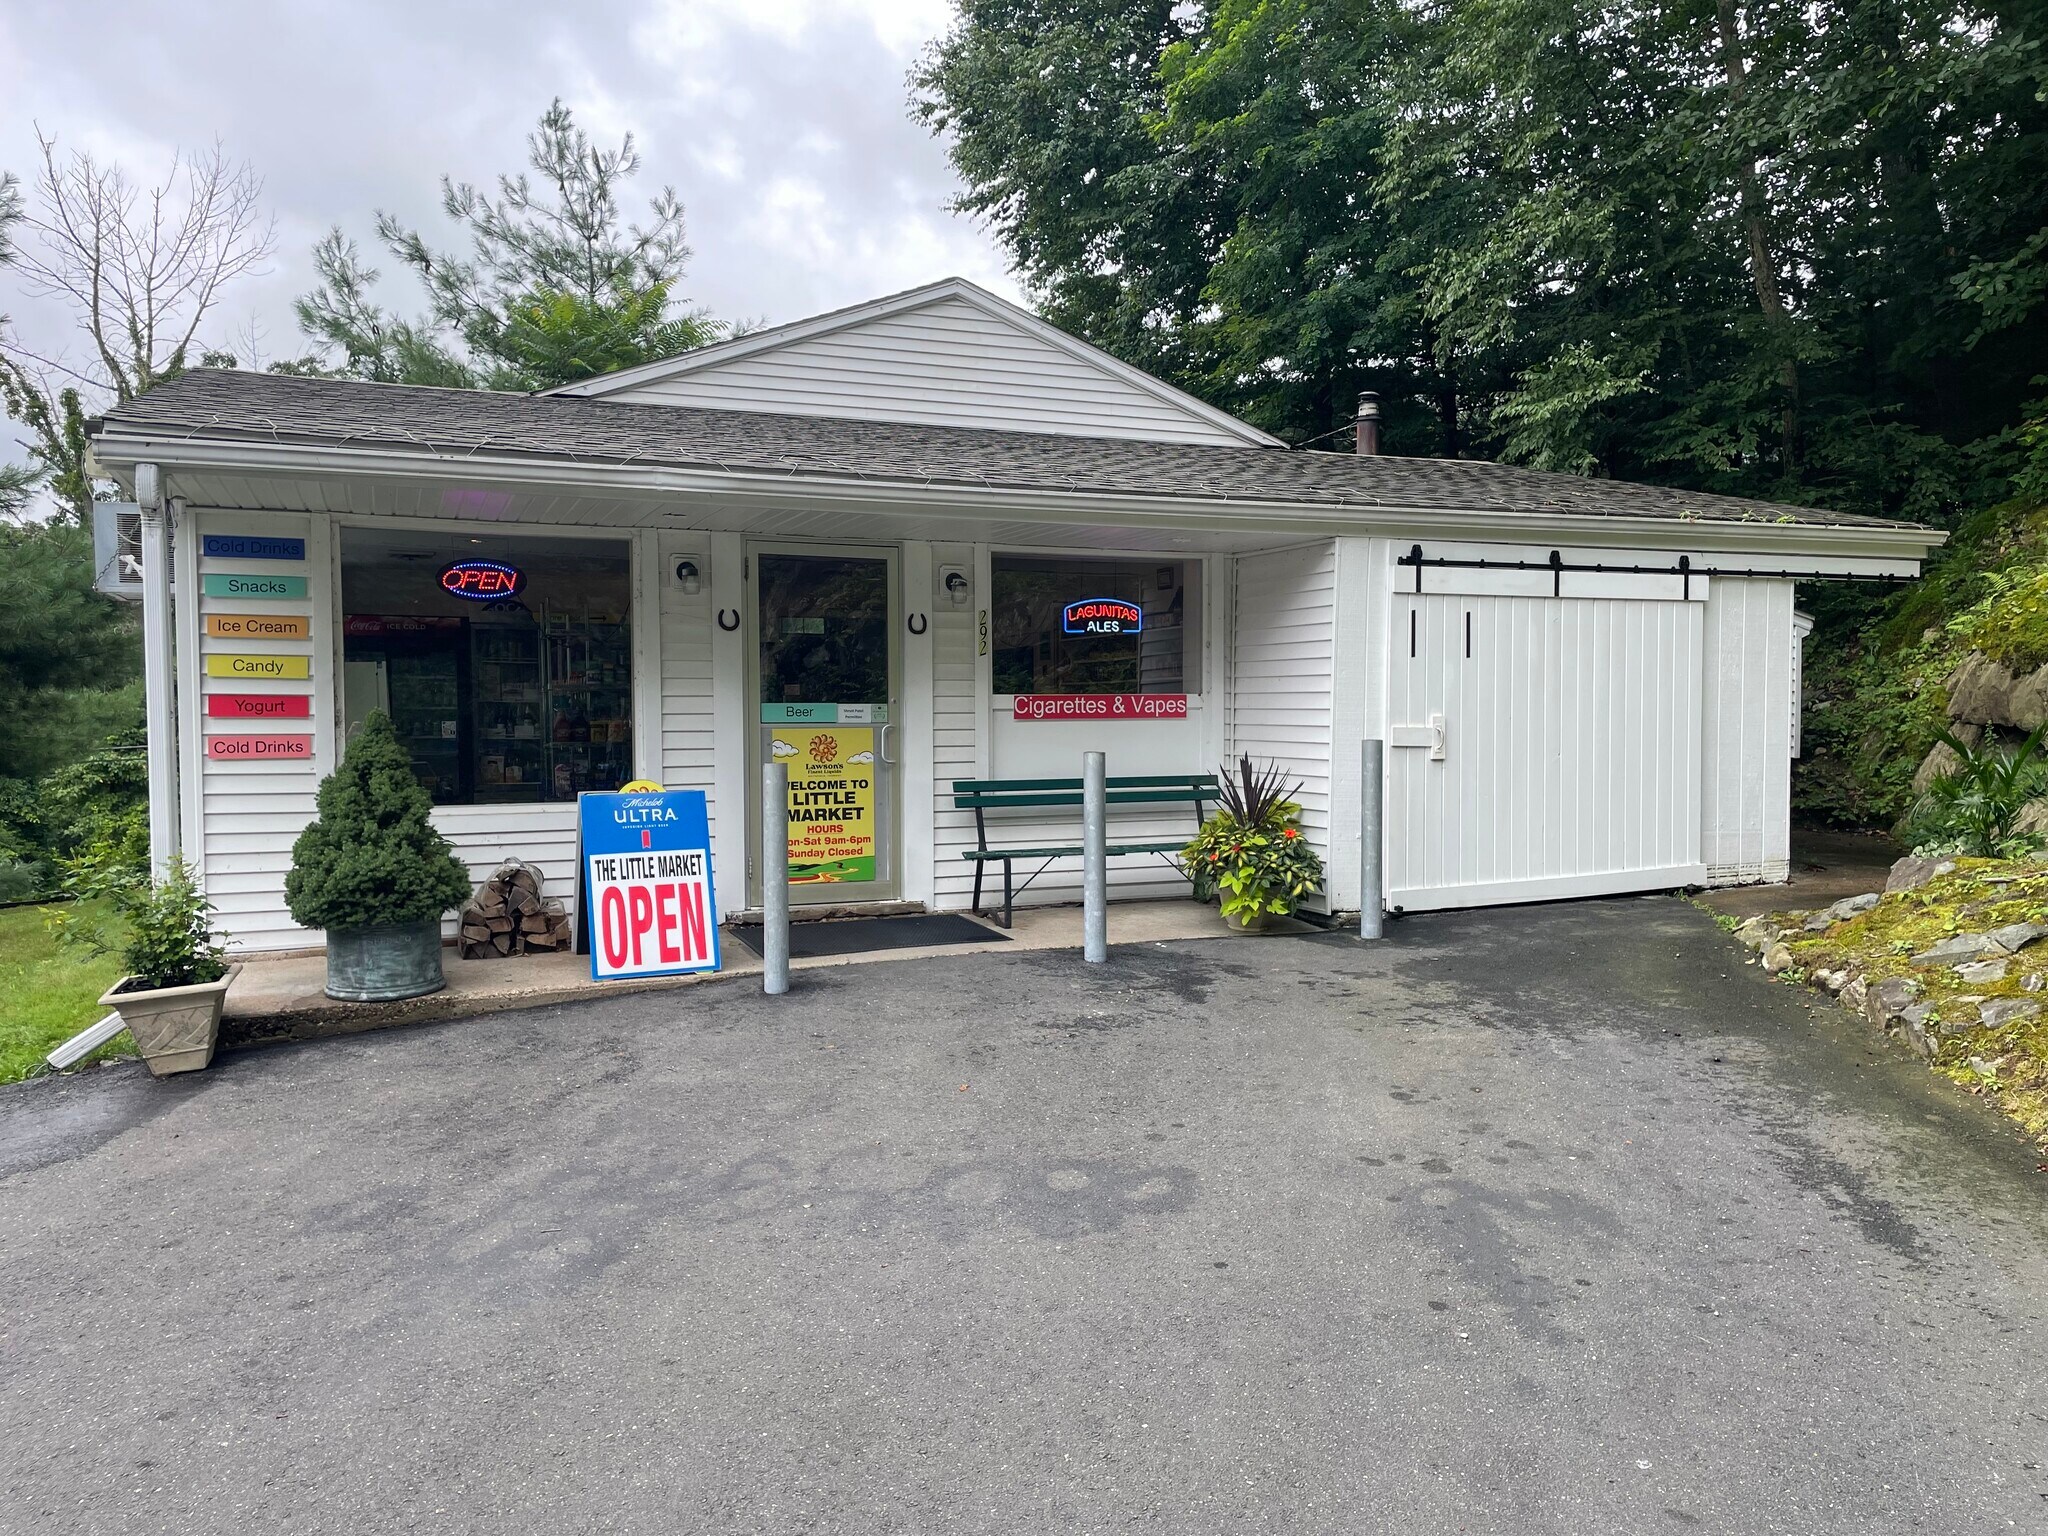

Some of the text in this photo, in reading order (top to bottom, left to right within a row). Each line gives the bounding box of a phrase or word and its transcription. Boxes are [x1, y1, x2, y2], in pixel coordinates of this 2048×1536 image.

[207, 540, 300, 556] Cold Drinks
[228, 579, 287, 594] Snacks
[442, 569, 518, 591] OPEN
[1067, 605, 1138, 622] LAGUNITAS
[217, 619, 298, 634] Ice Cream
[386, 623, 401, 631] ICE
[403, 623, 427, 631] COLD
[979, 610, 988, 656] 292
[1086, 620, 1120, 633] ALES
[232, 659, 284, 676] Candy
[234, 699, 285, 716] Yogurt
[786, 706, 814, 717] Beer
[1014, 696, 1187, 718] Cigarettes & Vapes
[214, 740, 304, 754] Cold Drinks
[788, 779, 869, 791] ELCOME TO
[622, 797, 664, 809] Michelob
[793, 791, 856, 806] LITTLE
[614, 807, 677, 824] ULTRA
[788, 807, 864, 823] MARKET
[807, 824, 844, 834] HOURS
[788, 835, 871, 847] on-Sat 9am-6pm
[788, 846, 863, 859] Sunday Closed
[595, 854, 702, 882] THE LITTLE MARKET
[601, 882, 708, 969] OPEN
